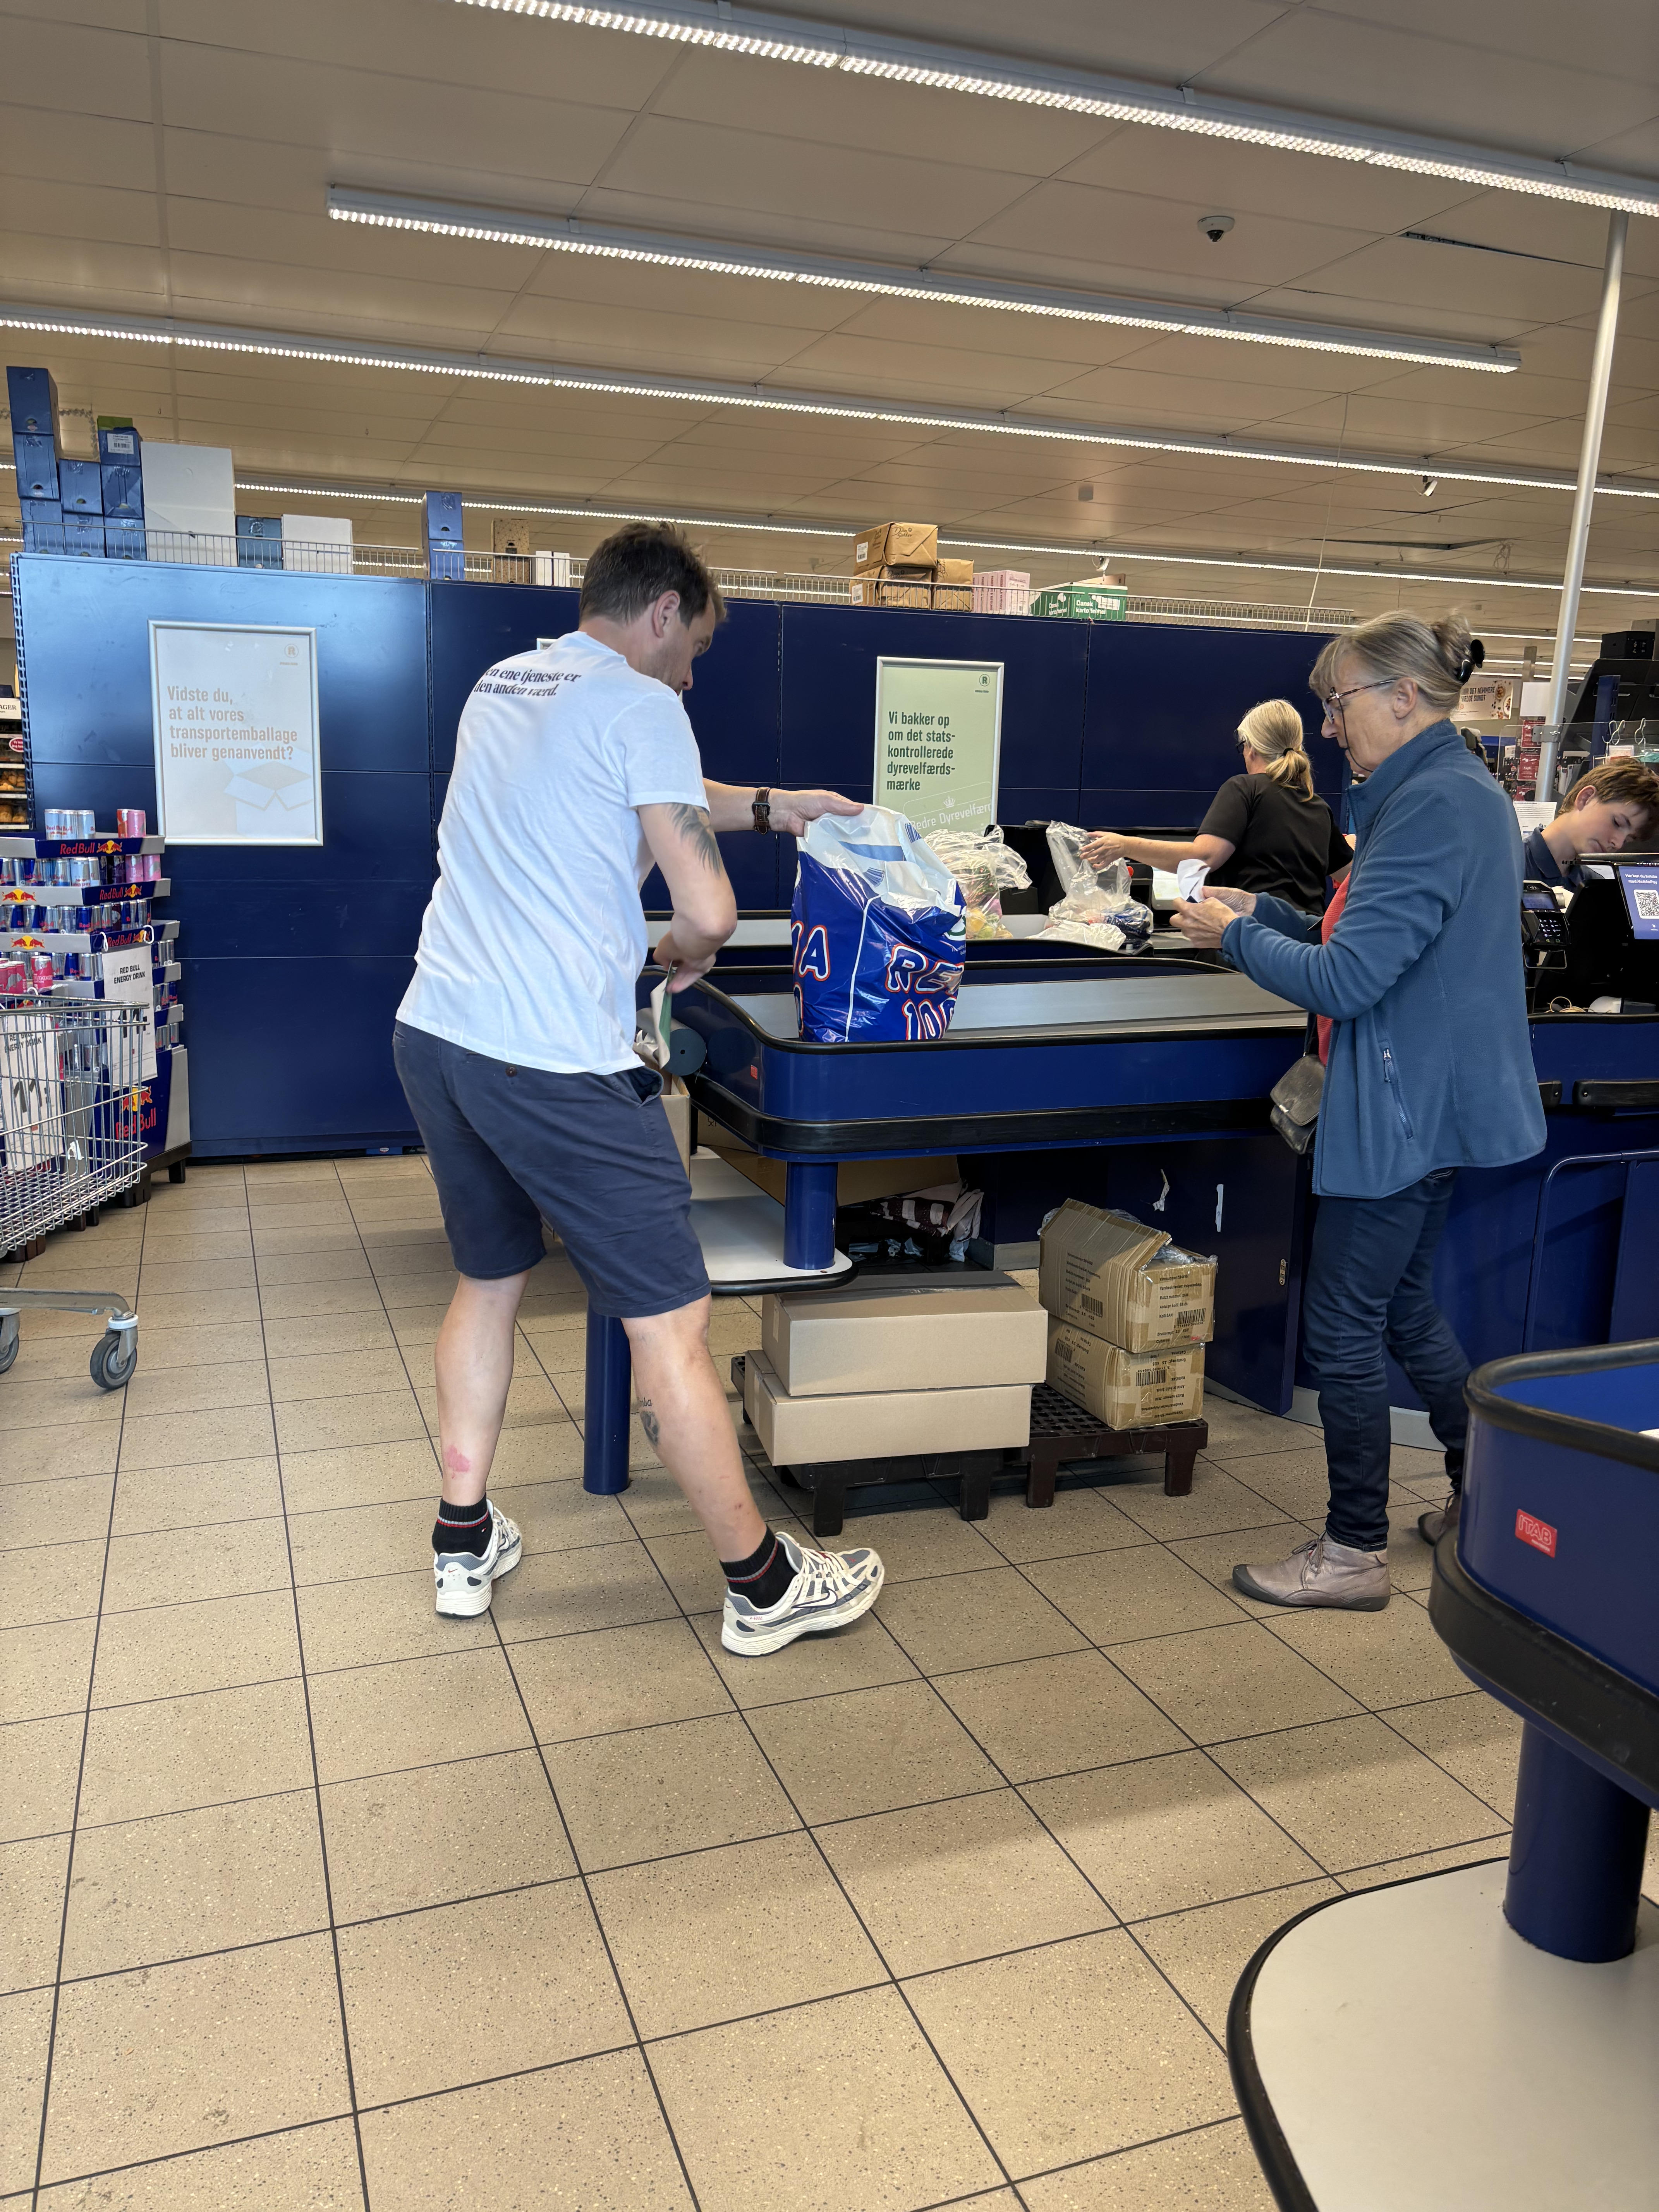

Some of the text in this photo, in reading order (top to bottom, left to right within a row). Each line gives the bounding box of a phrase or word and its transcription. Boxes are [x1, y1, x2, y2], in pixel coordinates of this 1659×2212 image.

[486, 668, 582, 685] en ene tjeneste er
[167, 685, 233, 705] Vidste du,
[474, 680, 560, 696] den anden værd.
[169, 706, 244, 721] at alt vores
[889, 711, 949, 728] Vi bakker op
[170, 725, 297, 744] transportemballage
[888, 729, 955, 742] om det stats-
[171, 743, 294, 761] bliver genanvendt?
[888, 744, 953, 759] kontrollerede
[887, 761, 955, 776] dyrevelfærds-
[887, 778, 920, 790] mærke
[911, 816, 936, 830] Bedre
[60, 842, 95, 855] Red Bull
[100, 886, 124, 900] Red Bull
[107, 933, 132, 947] Red Bull
[130, 964, 140, 972] BULL
[114, 971, 146, 984] ENERGY DRINK
[1519, 1515, 1552, 1545] ITAB
